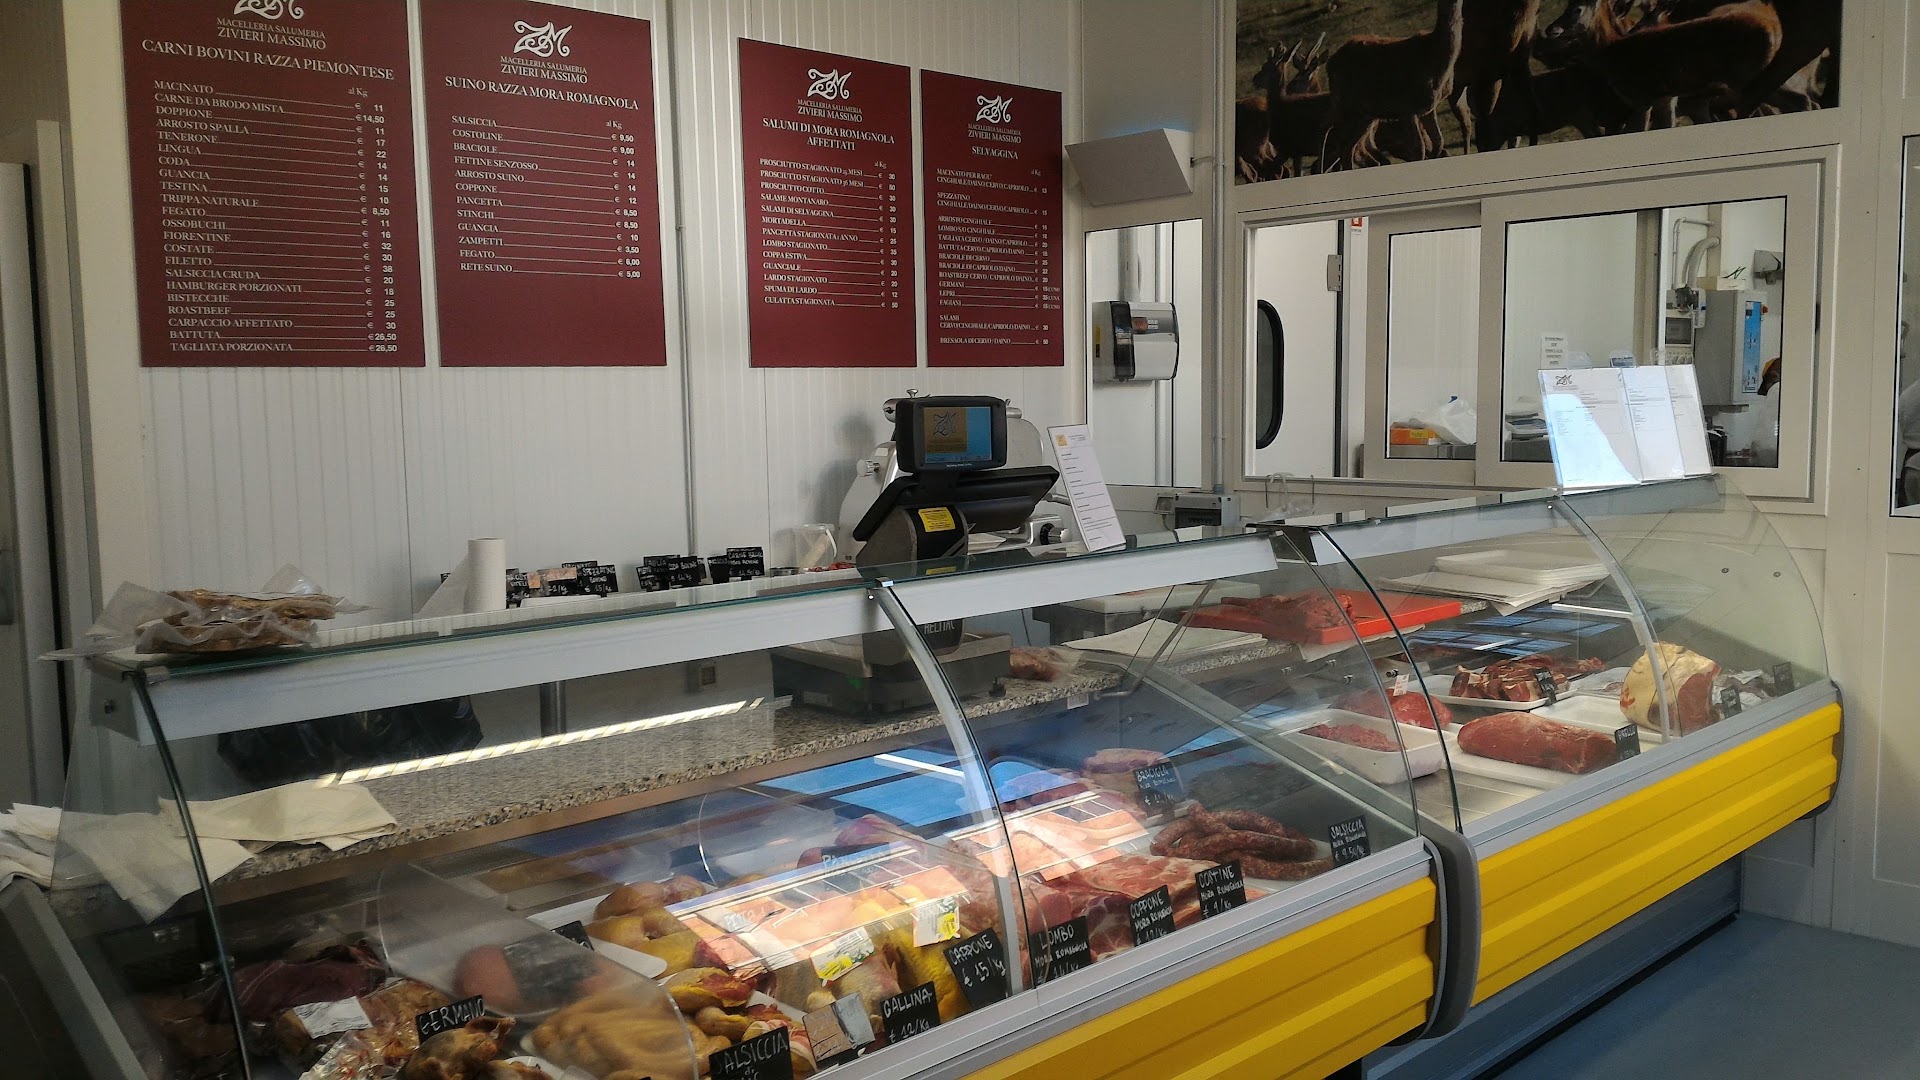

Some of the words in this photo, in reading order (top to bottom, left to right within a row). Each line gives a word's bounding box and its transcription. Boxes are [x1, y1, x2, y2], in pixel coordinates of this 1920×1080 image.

[217, 18, 273, 32] MACELLERIA
[276, 24, 325, 38] SALUMERIA
[218, 27, 264, 42] ZIVIERI
[268, 33, 326, 49] MASSIMO
[142, 40, 192, 56] CARNI
[197, 46, 250, 62] BOVINI
[254, 52, 301, 68] RAZZA
[304, 59, 394, 80] PIEMONTESE
[500, 56, 545, 68] MACELLERIA
[547, 62, 587, 74] SALUMERIA
[501, 64, 538, 77] ZIVIERI
[541, 70, 587, 84] MASSIMO
[155, 80, 213, 94] MACINATO
[445, 76, 485, 91] SUINO
[488, 82, 527, 96] RAZZA
[529, 86, 564, 100] MORA
[567, 91, 638, 110] ROMAGNOLA
[154, 93, 193, 104] CARNE
[195, 97, 210, 106] DA
[212, 99, 250, 110] BRODO
[252, 102, 284, 113] MISTA
[363, 114, 384, 124] 14,50
[156, 106, 212, 119] DOPPIONE
[798, 106, 825, 117] ZIVIERI
[827, 111, 862, 122] MASSIMO
[156, 119, 207, 130] ARROSTO
[210, 123, 249, 134] SPALLA
[452, 116, 497, 127] SALSICCIA
[453, 129, 503, 141] COSTOLINE
[763, 118, 798, 131] SALUMI
[801, 122, 810, 132] DI
[812, 124, 838, 137] MORA
[840, 127, 894, 144] ROMAGNOLA
[157, 131, 217, 143] TENERONE
[158, 144, 201, 155] LINGUA
[454, 143, 497, 153] BRACIOLE
[807, 137, 855, 151] AFFETTATI
[972, 146, 1018, 159] SELVAGGINA
[158, 156, 190, 166] CODA
[455, 156, 492, 166] FETTINE
[160, 169, 210, 180] GUANCIA
[455, 170, 496, 180] ARROSTO
[497, 173, 524, 182] SUINO
[160, 181, 207, 192] TESTINA
[456, 183, 497, 193] COPPONE
[160, 194, 199, 203] TRIPPA
[202, 197, 258, 207] NATURALE
[457, 196, 503, 206] PANCETTA
[162, 207, 205, 216] FEGATO
[457, 210, 494, 219] STINCHI
[162, 219, 225, 229] OSSOBUCHI
[458, 223, 499, 232] GUANCIA
[164, 231, 230, 242] FIORENTINE
[459, 236, 502, 246] ZAMPETTI
[164, 243, 214, 253] COSTATE
[460, 250, 495, 258] FEGATO
[165, 256, 211, 266] FILETTO
[461, 263, 484, 271] RETE
[485, 264, 512, 272] SUINO
[166, 269, 222, 278] SALSICCIA
[223, 270, 261, 279] CRUDA
[167, 281, 237, 291] HAMBURGER
[239, 284, 301, 293] PORZIONATI
[167, 293, 229, 303] BISTECCHE
[168, 306, 231, 314] ROASTBEEF
[168, 318, 230, 327] CARPACCIO
[170, 331, 220, 339] BATTUTA
[170, 343, 224, 351] TAGLIATA
[226, 343, 293, 351] PORZIONATA
[1199, 865, 1234, 888] COSTINE
[1130, 891, 1163, 919] COPPONE
[1039, 925, 1074, 950] LOMBO
[949, 934, 992, 965] CAPPONE
[715, 1032, 788, 1075] ALSICCIA
